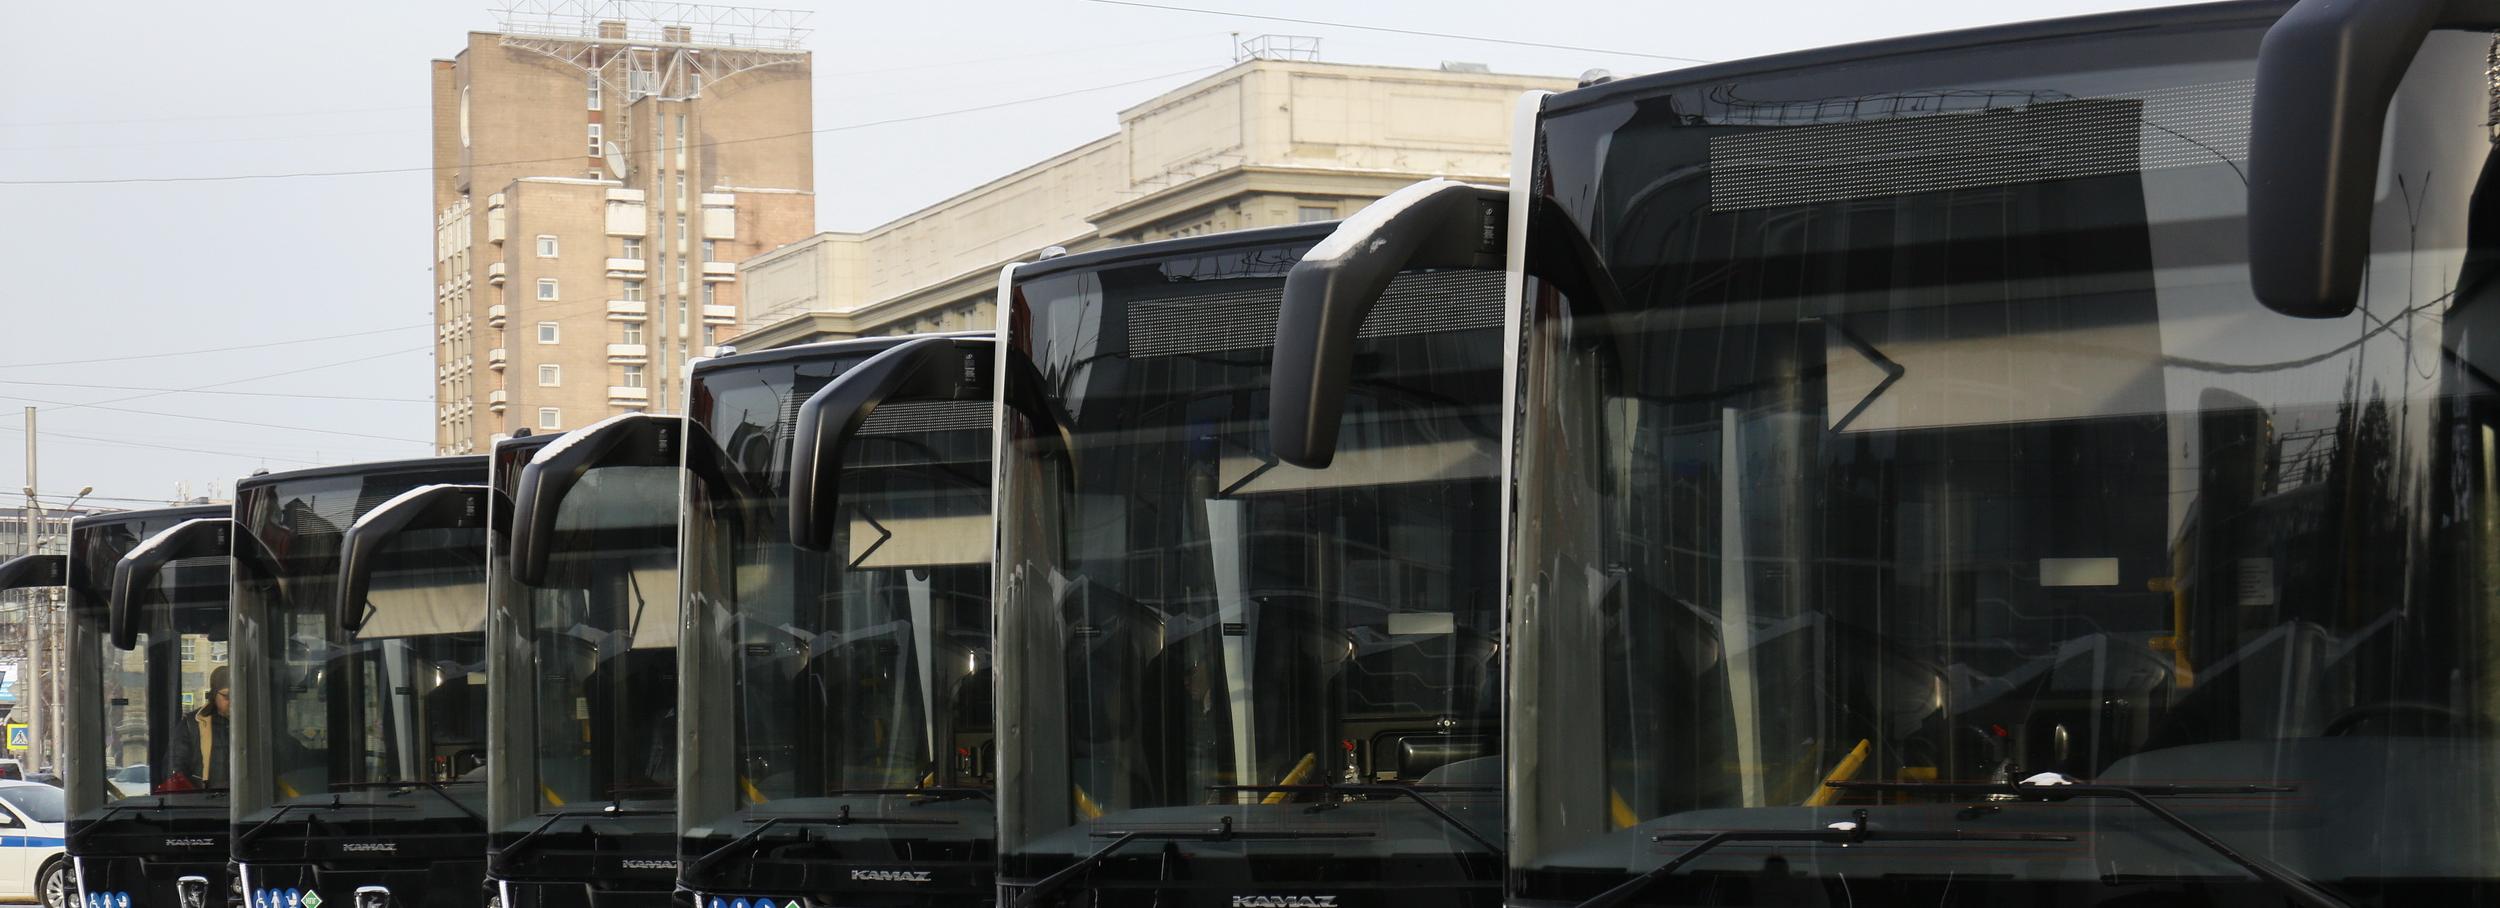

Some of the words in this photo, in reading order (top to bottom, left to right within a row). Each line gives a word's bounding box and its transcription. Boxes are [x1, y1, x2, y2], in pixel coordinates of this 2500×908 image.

[343, 843, 397, 852] KAMAZ
[851, 869, 932, 882] KAMAZ
[1232, 895, 1338, 908] KAMAZ
